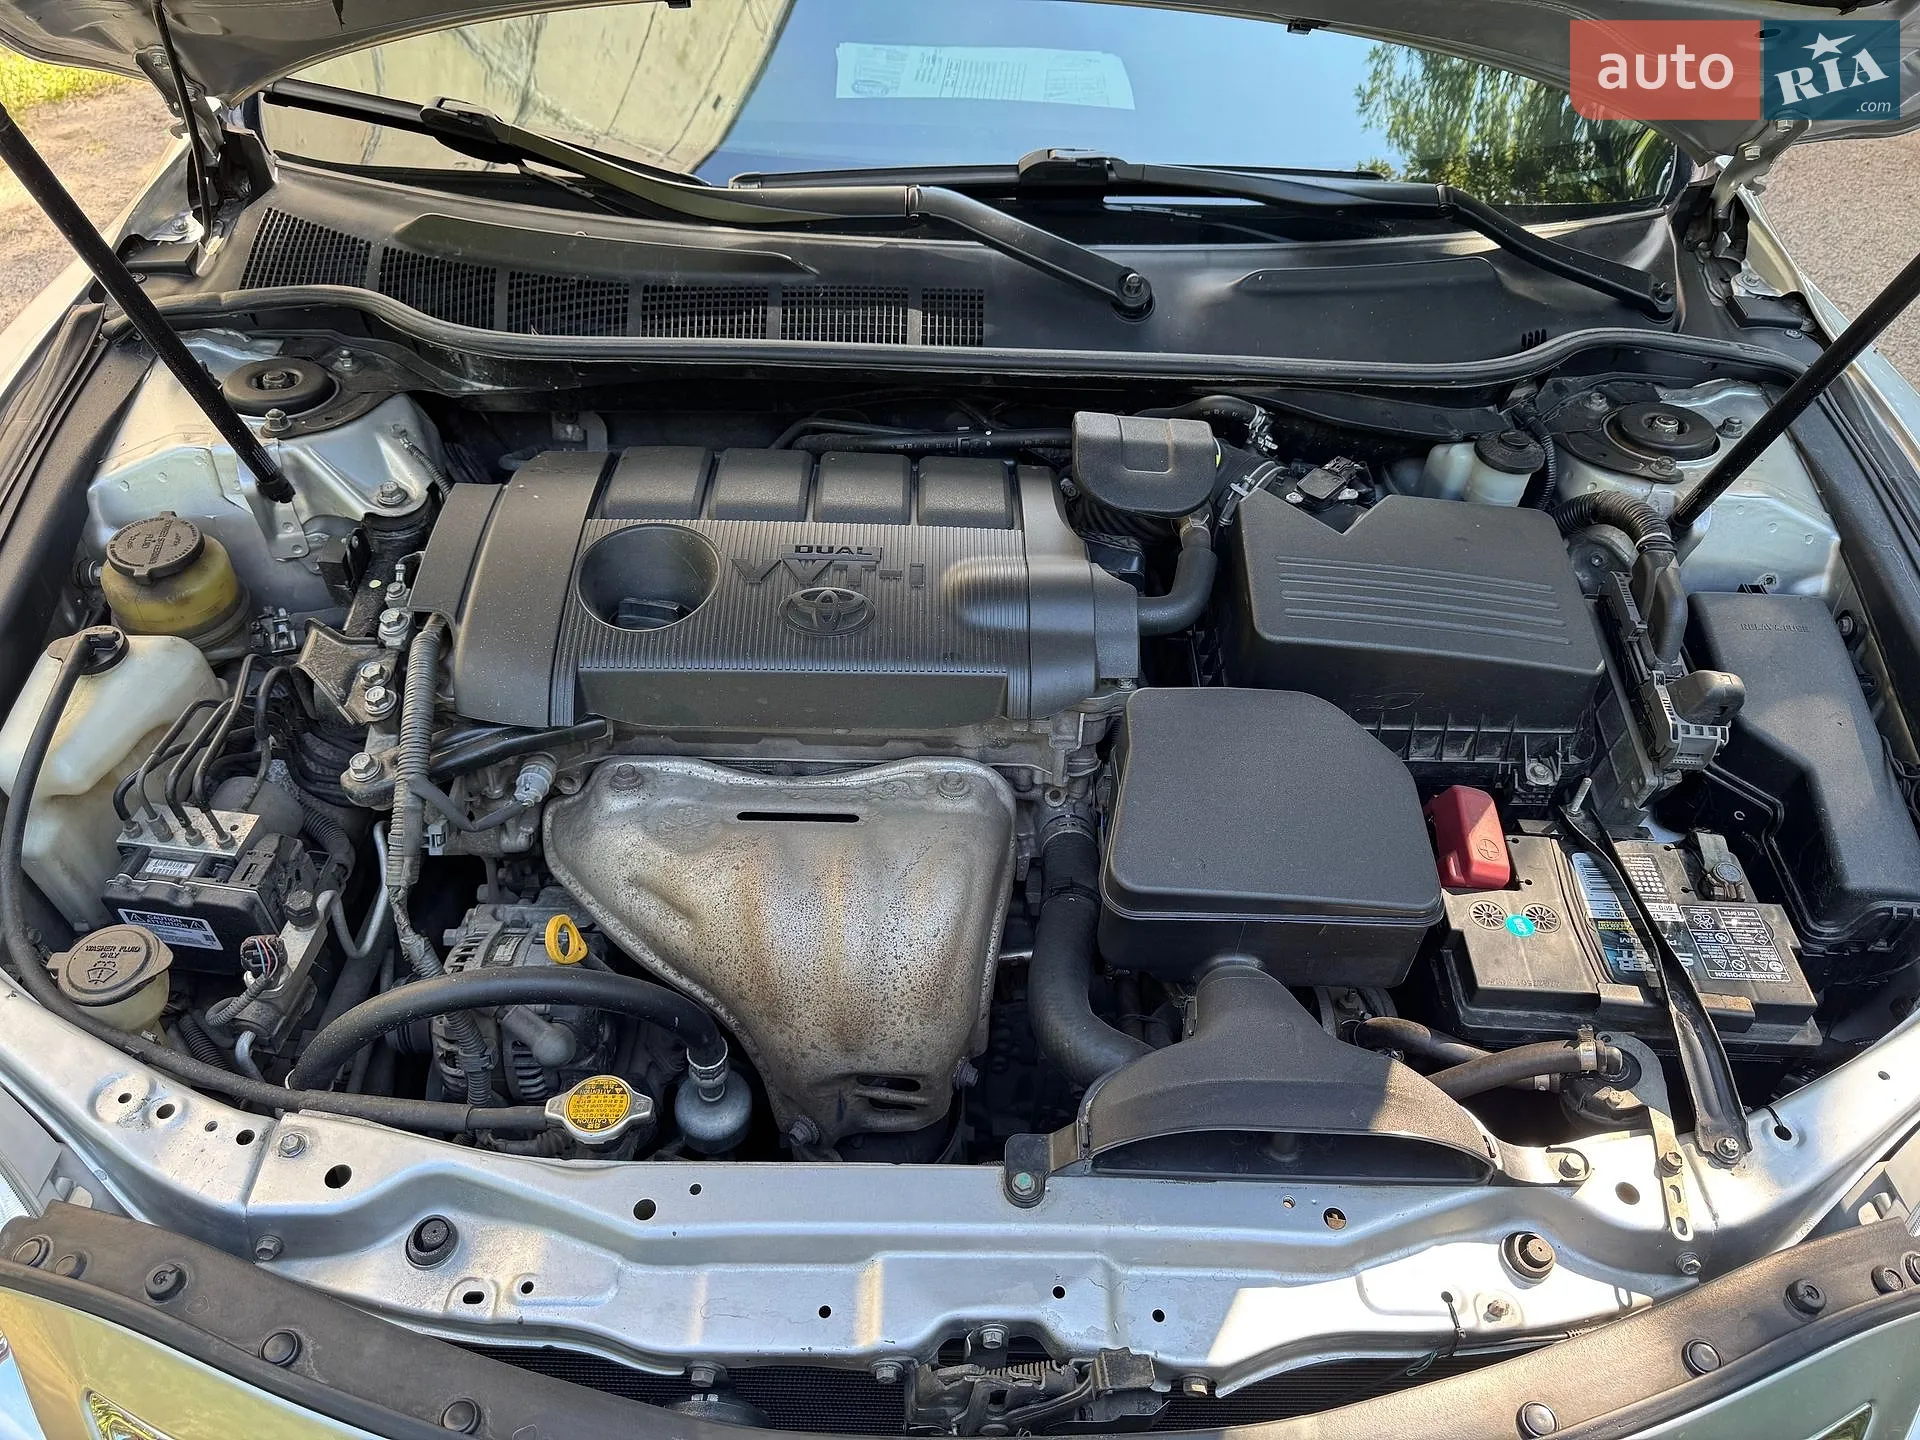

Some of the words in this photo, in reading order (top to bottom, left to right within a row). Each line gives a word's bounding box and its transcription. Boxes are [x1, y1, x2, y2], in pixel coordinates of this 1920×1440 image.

[794, 545, 873, 556] DUAL
[146, 914, 182, 923] CAUTION
[146, 919, 189, 929] ATTENTION
[118, 945, 141, 953] FLUID
